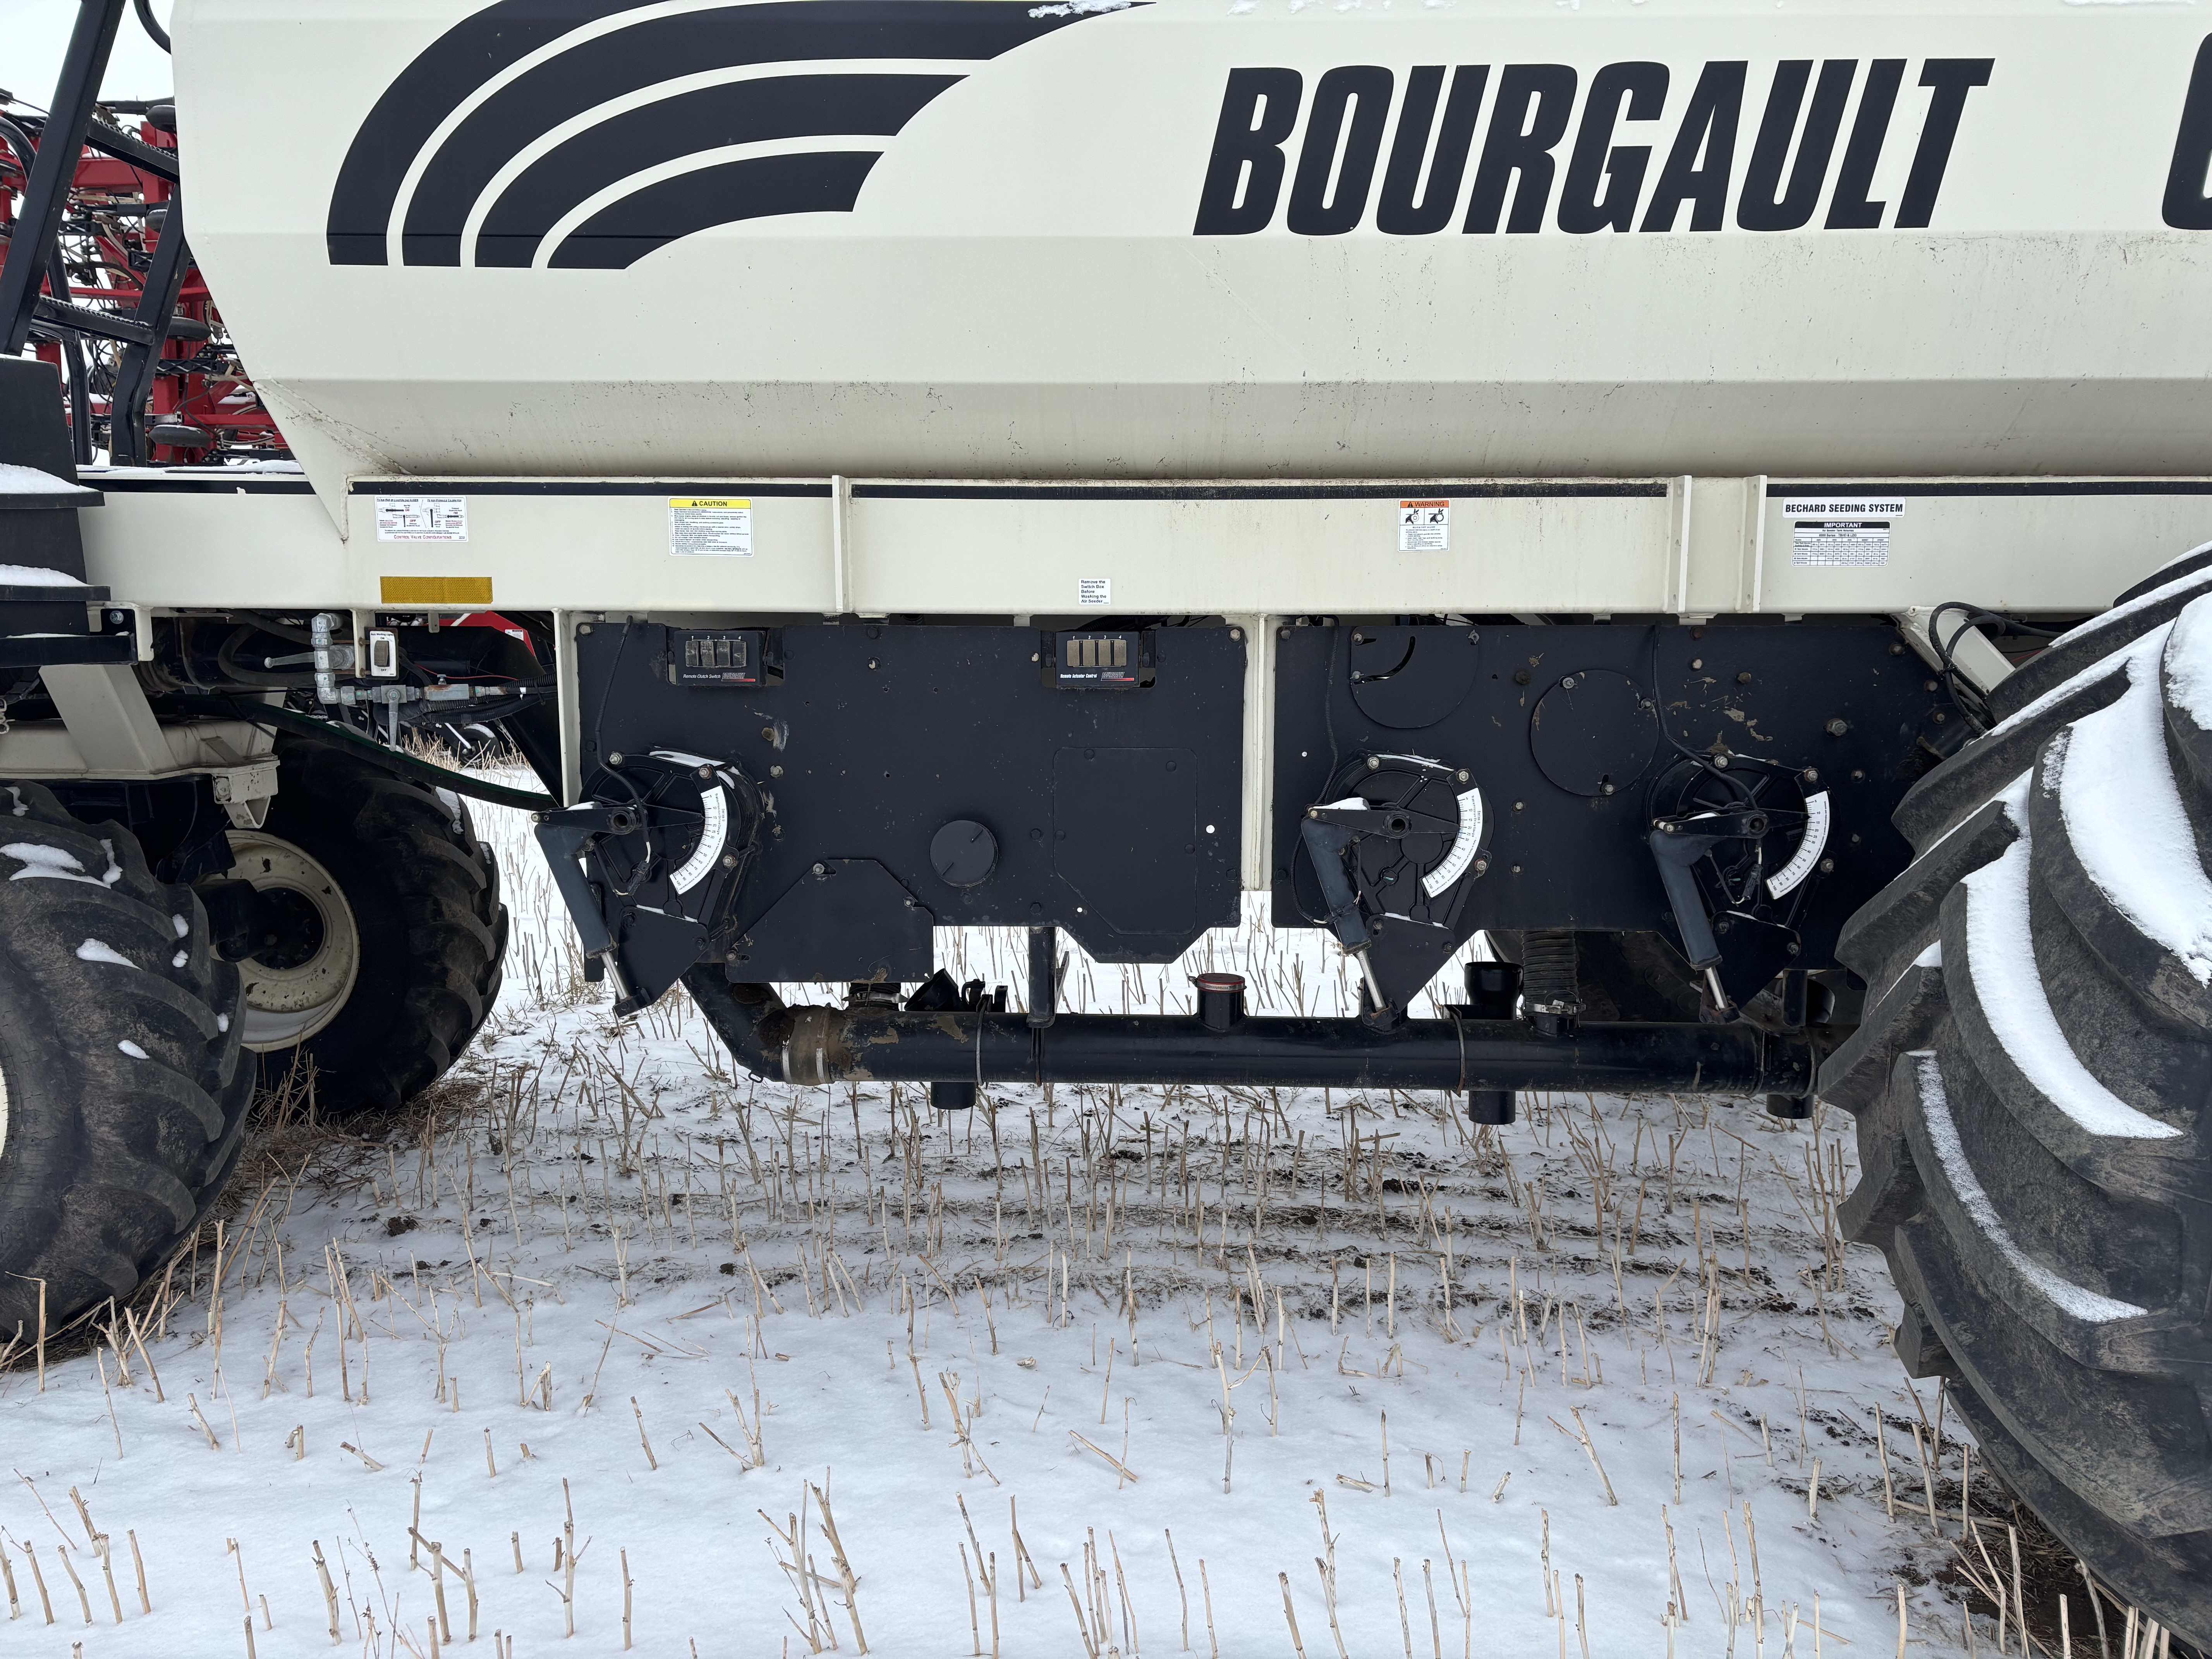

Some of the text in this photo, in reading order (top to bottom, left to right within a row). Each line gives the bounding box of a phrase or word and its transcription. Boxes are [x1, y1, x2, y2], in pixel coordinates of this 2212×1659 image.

[1192, 57, 1996, 235] BOURGAULT
[1786, 504, 1903, 512] BECHARD SEEDING SYSTEM
